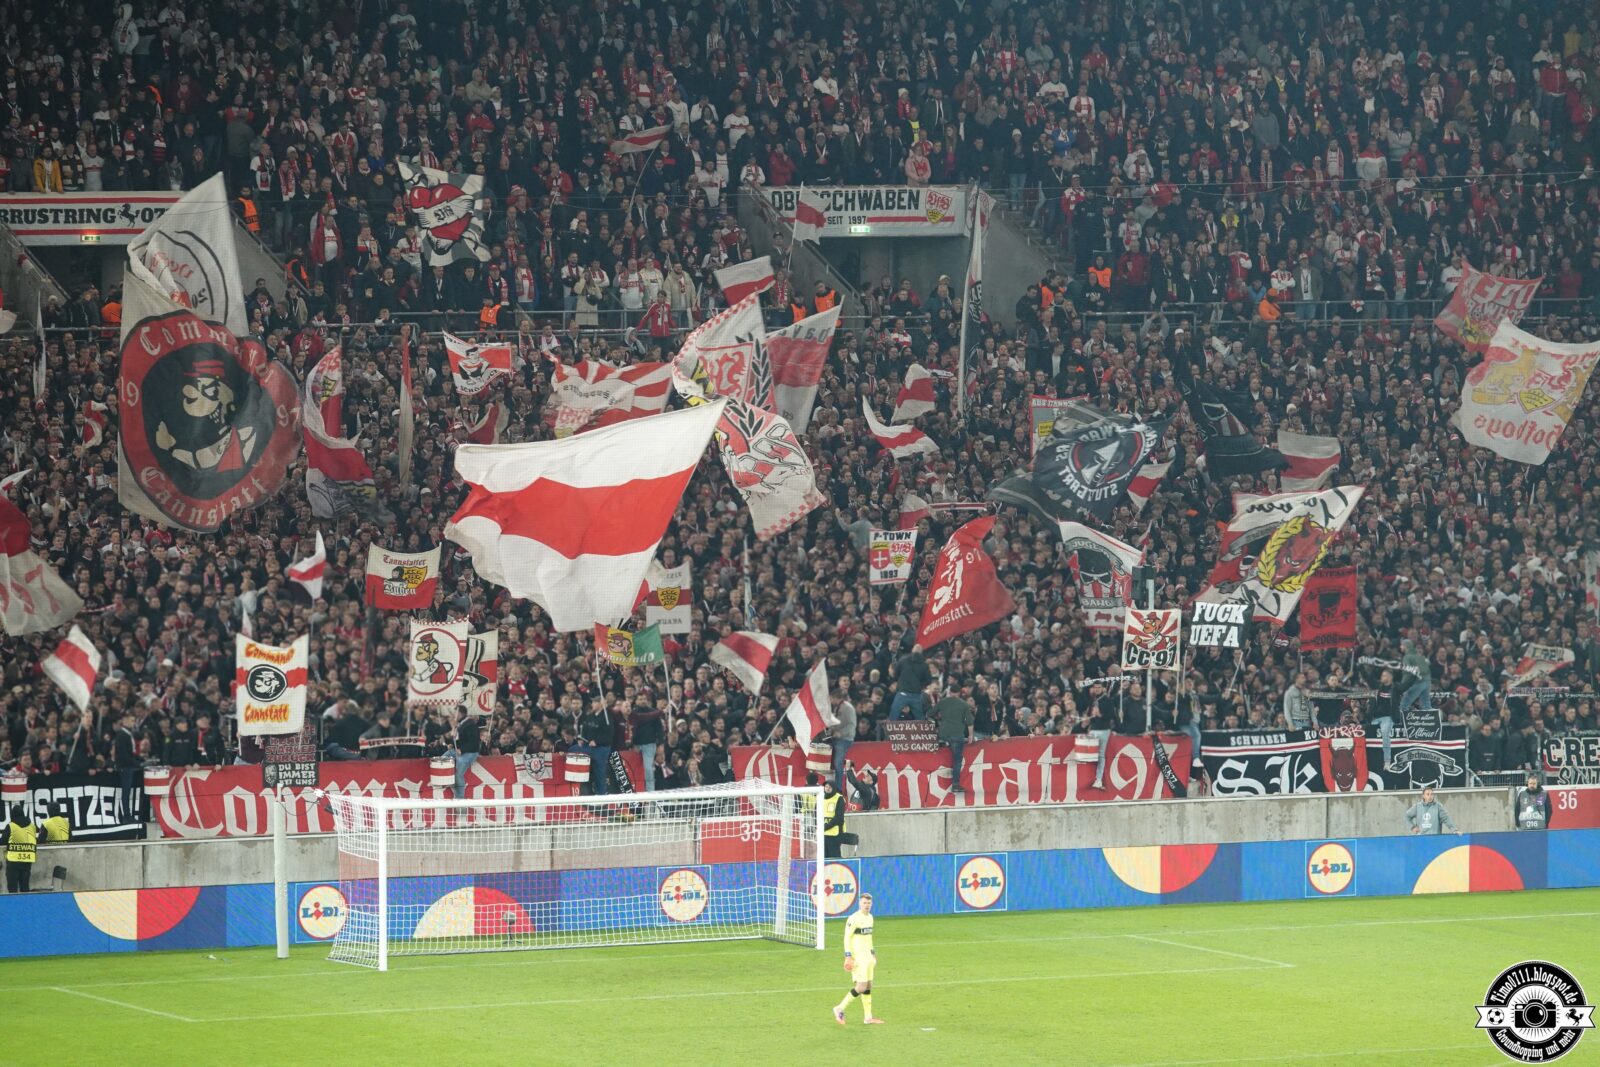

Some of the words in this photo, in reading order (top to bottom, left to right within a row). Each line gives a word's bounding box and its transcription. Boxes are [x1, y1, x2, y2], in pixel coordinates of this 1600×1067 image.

[772, 190, 921, 212] OBSCHWABEN
[827, 216, 843, 225] SEIT
[848, 215, 867, 225] 1997
[1192, 601, 1249, 624] FUCK
[1189, 625, 1240, 648] UEFA
[886, 723, 917, 731] ULTRA
[920, 723, 936, 731] IST
[1319, 724, 1366, 739] ULTRAS
[889, 733, 907, 741] DER
[1230, 732, 1287, 745] SCHWABEN
[1304, 729, 1318, 741] KO
[1376, 727, 1408, 738] SUTT
[891, 743, 909, 752] UMS
[278, 762, 292, 771] DU
[295, 762, 316, 771] BIST
[278, 771, 316, 779] IMMER
[295, 778, 316, 786] UNS!
[1558, 791, 1578, 810] 36
[1526, 820, 1539, 828] 016
[740, 822, 762, 842] 35
[9, 844, 36, 852] STEWA
